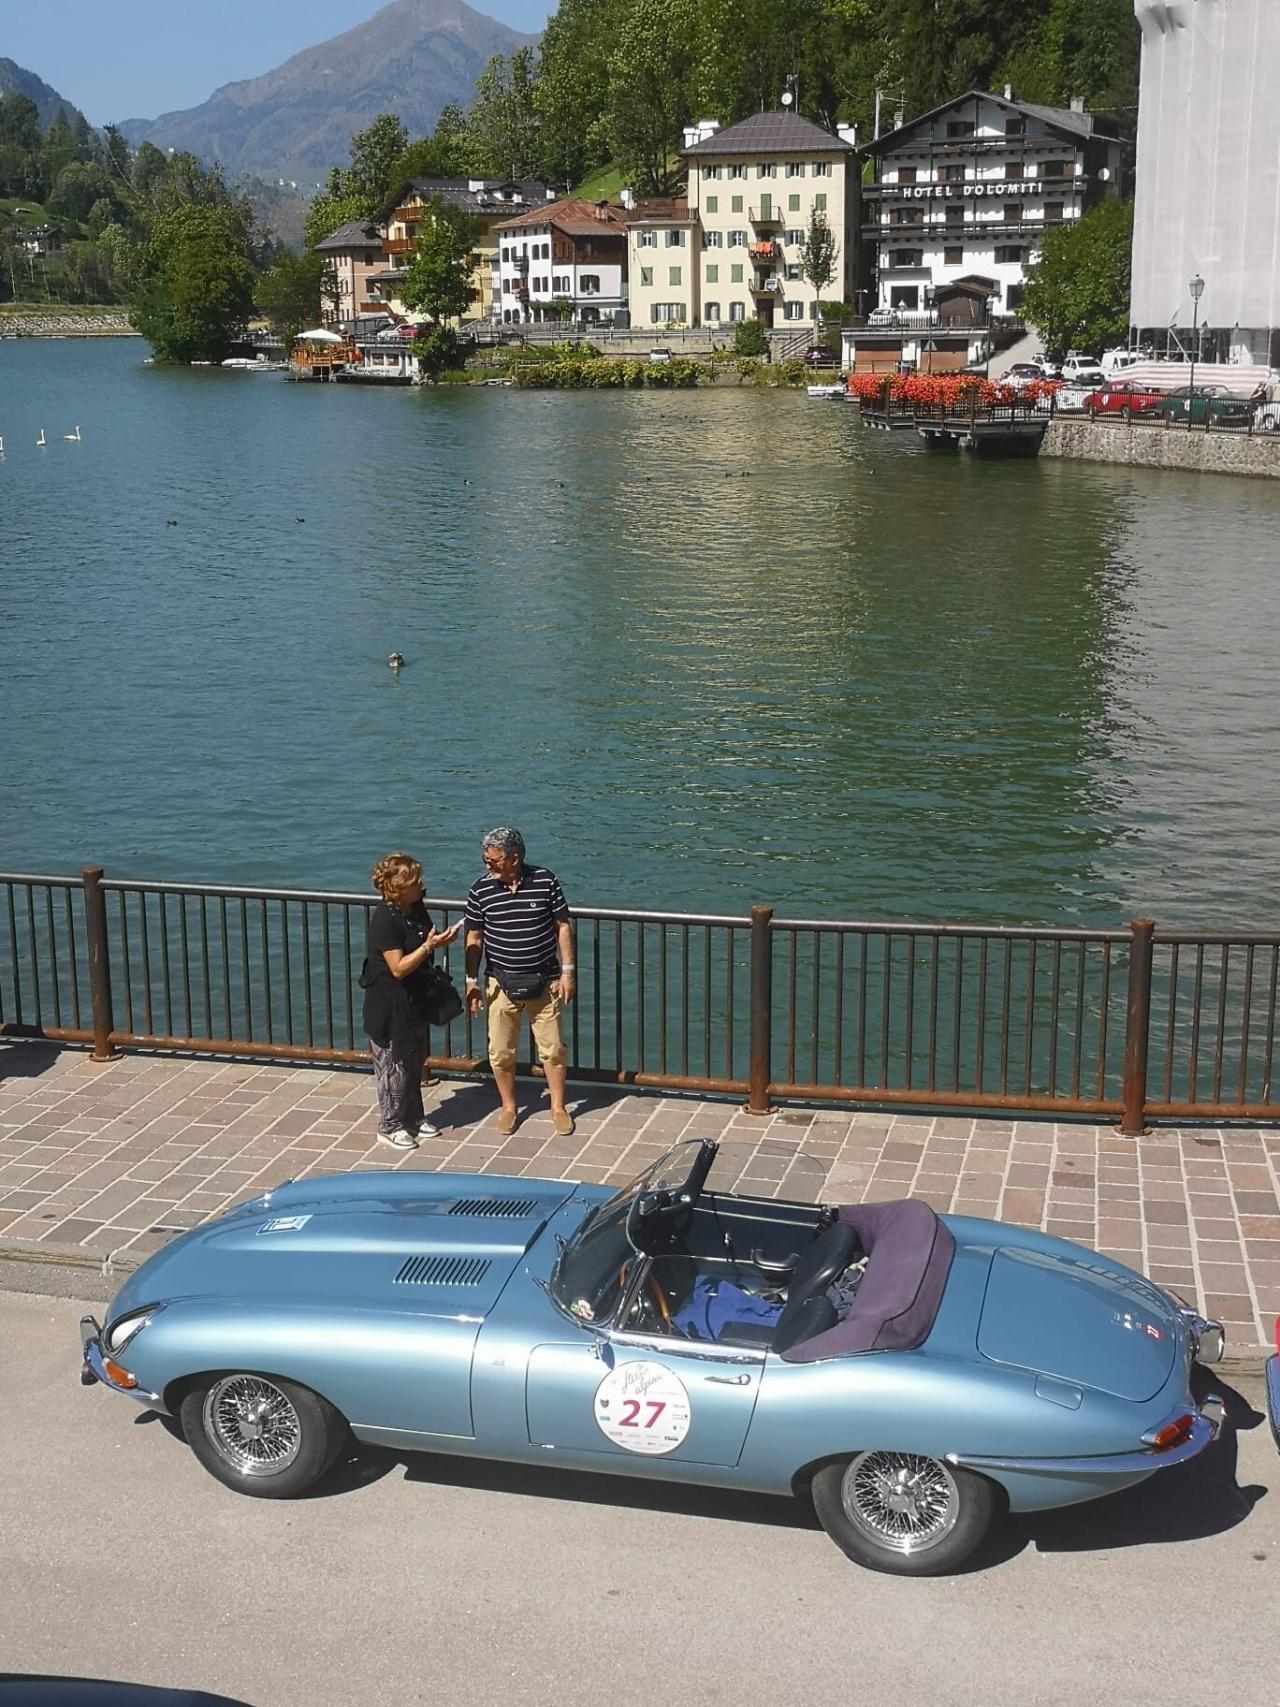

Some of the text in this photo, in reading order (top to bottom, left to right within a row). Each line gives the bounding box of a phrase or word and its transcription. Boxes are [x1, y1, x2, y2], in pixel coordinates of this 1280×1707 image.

[903, 182, 1043, 198] HOTEL DOLOMITI
[618, 1399, 666, 1429] 27
